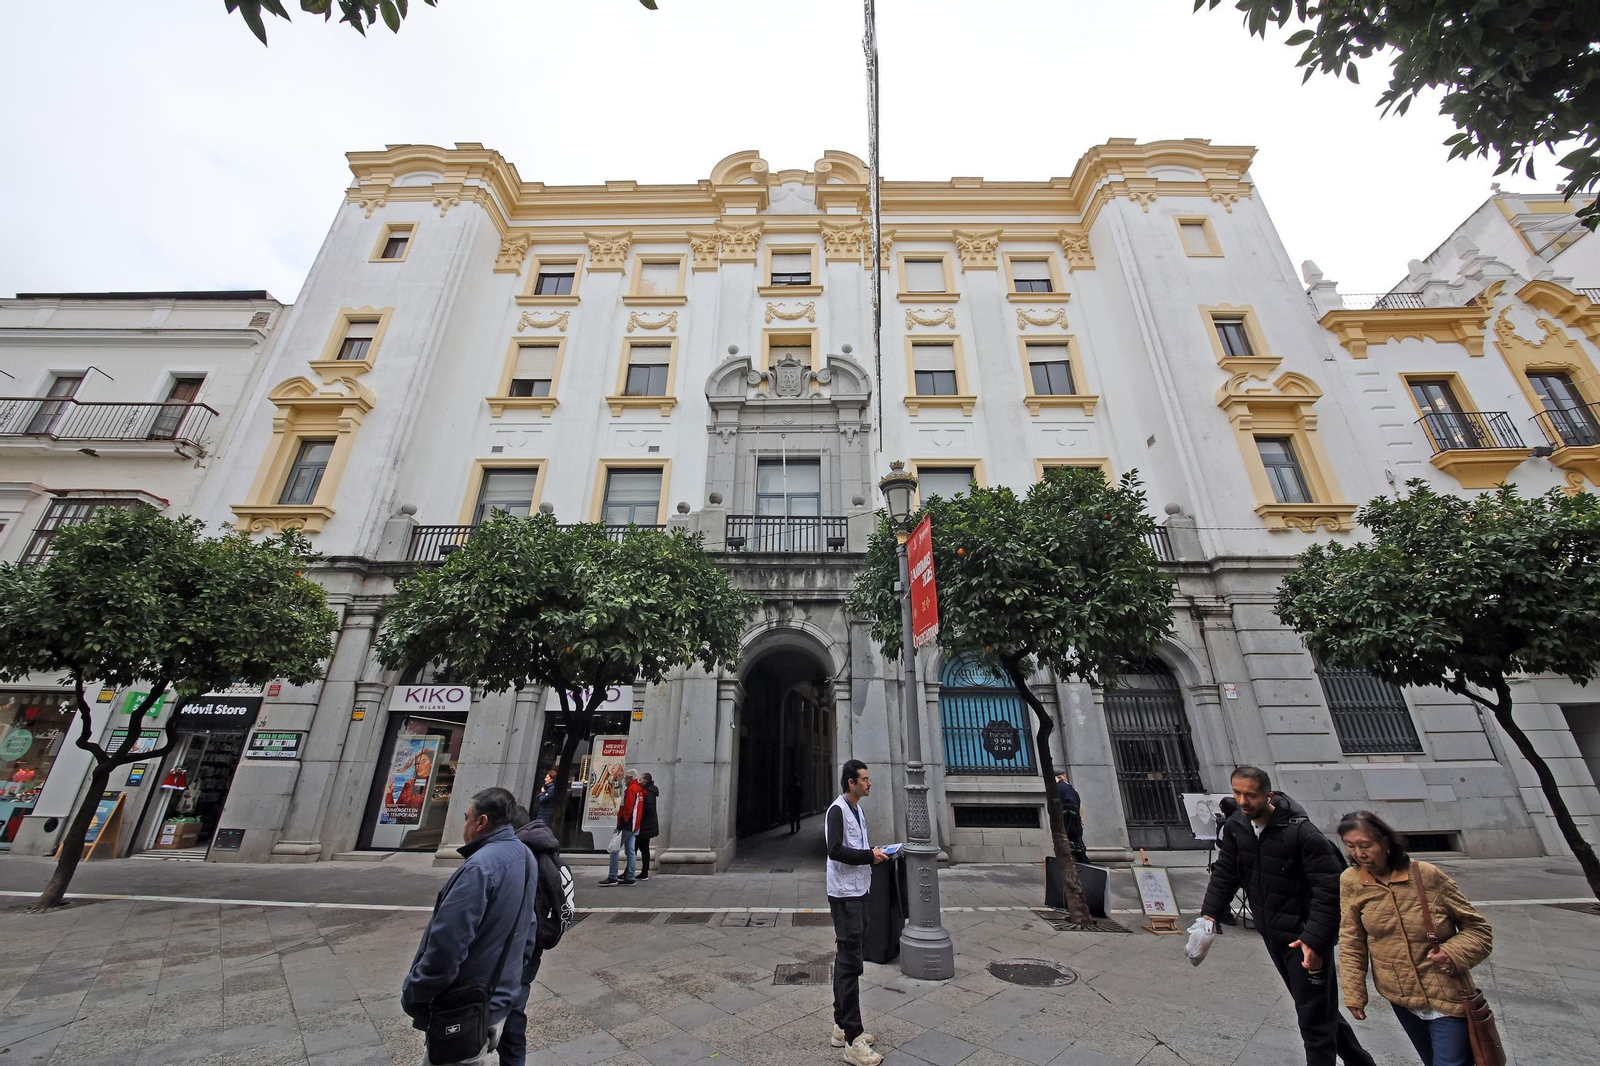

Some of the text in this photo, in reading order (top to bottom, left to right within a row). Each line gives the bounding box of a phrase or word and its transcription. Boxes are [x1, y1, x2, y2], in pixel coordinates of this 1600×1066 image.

[405, 687, 464, 703] KIKO
[181, 703, 247, 715] Móvil Store
